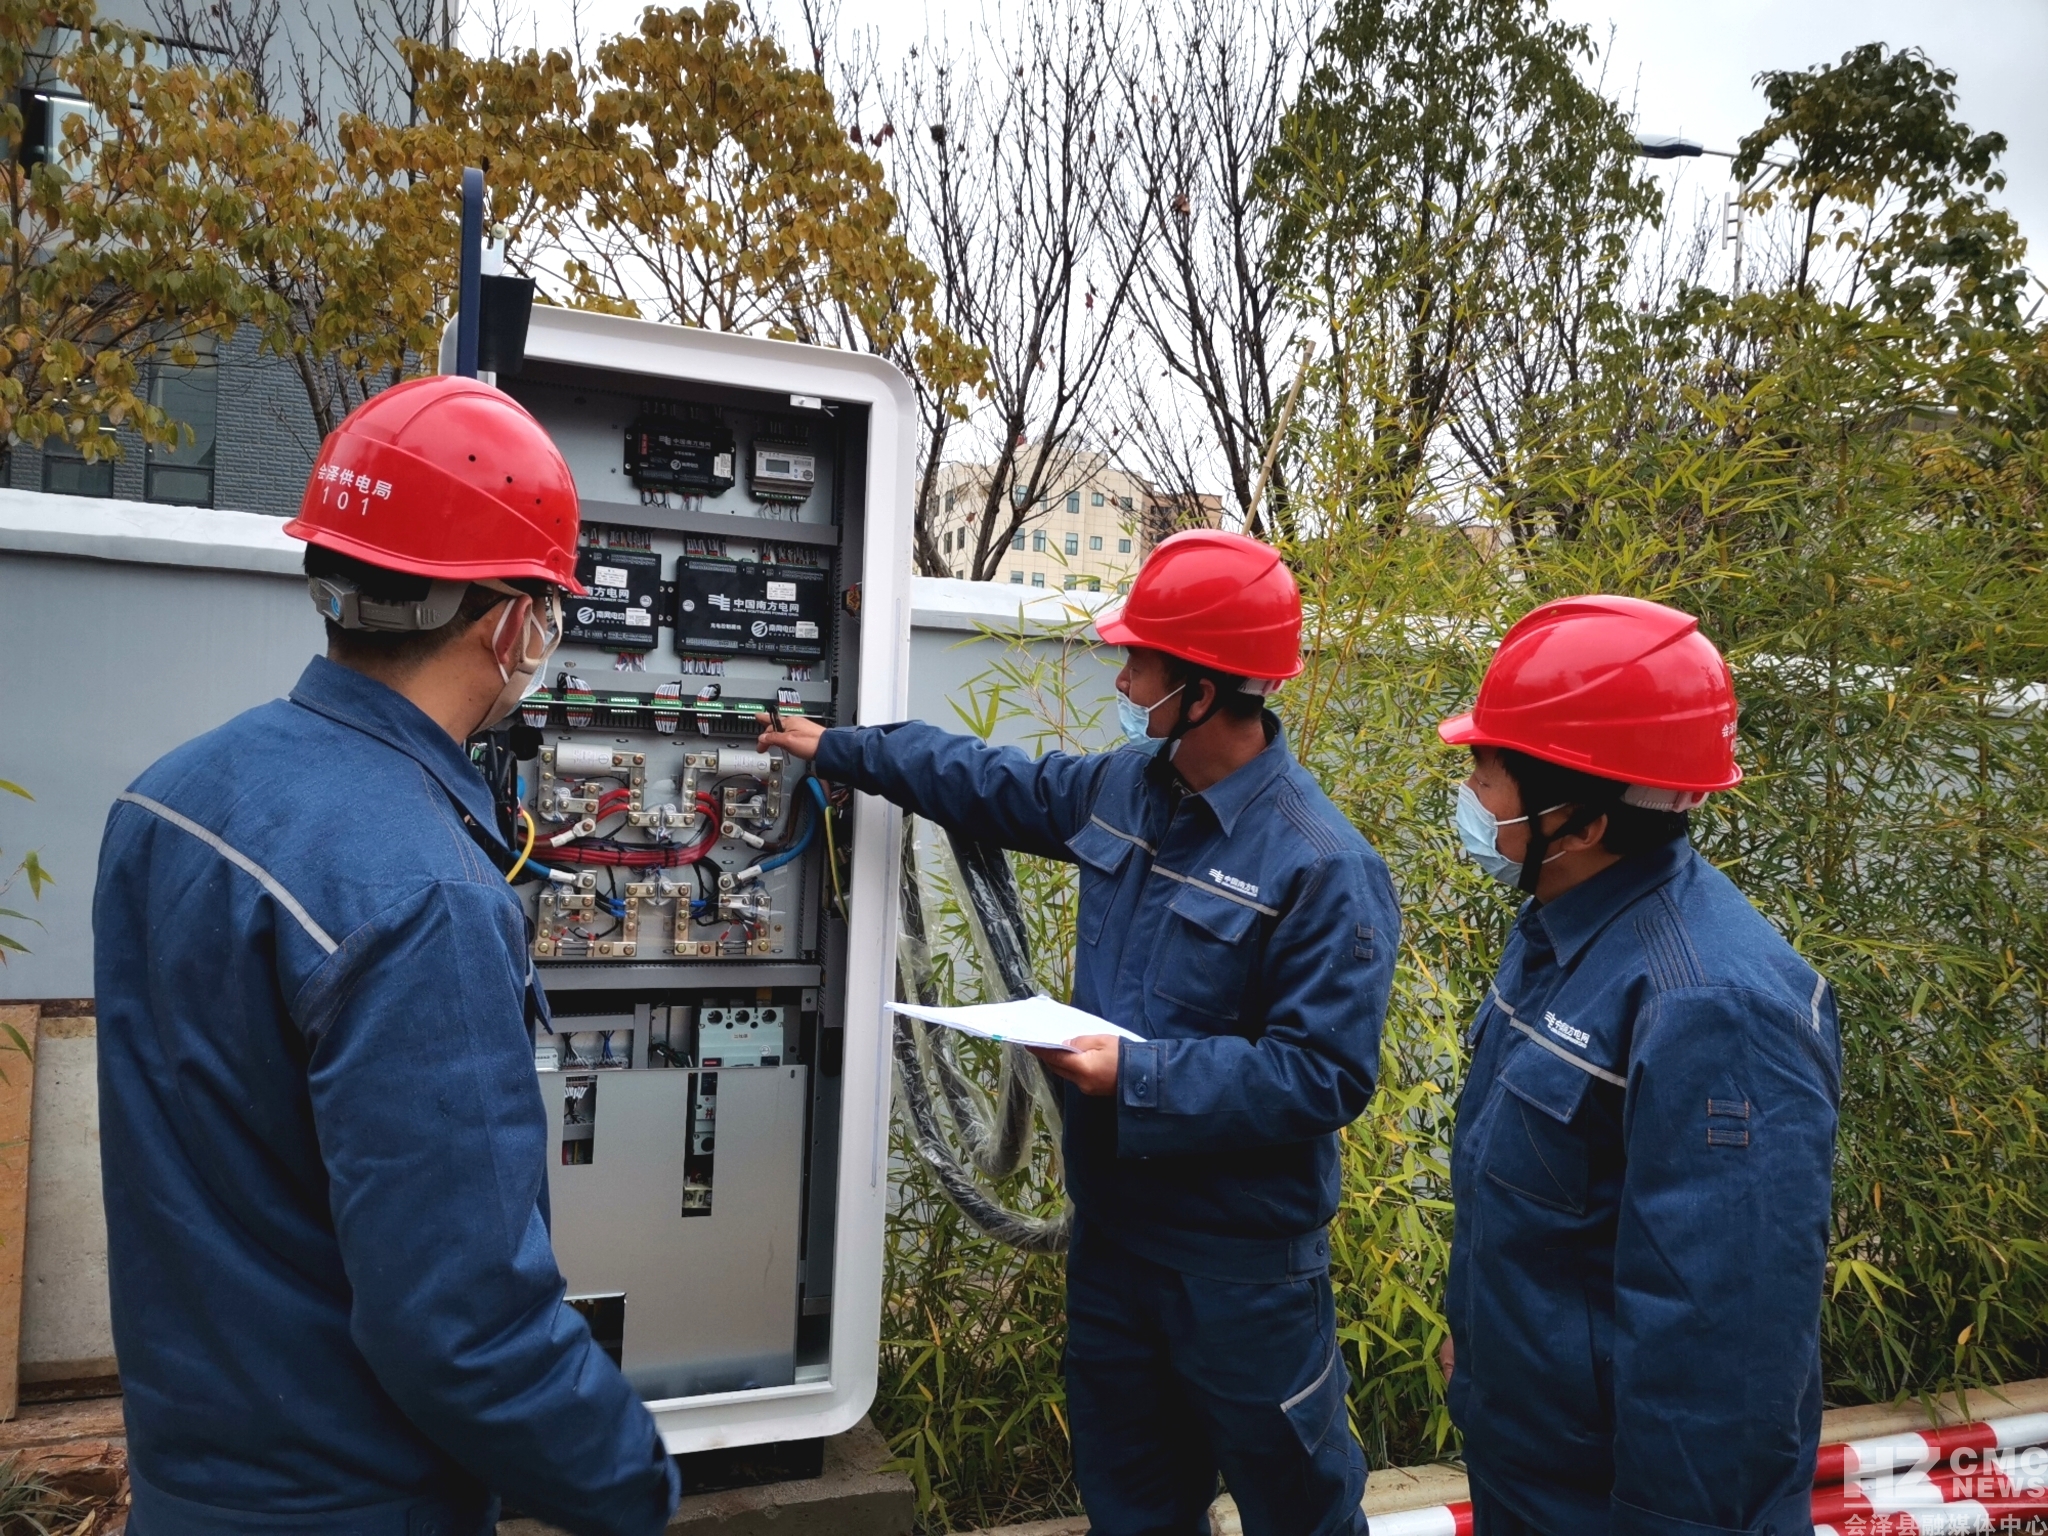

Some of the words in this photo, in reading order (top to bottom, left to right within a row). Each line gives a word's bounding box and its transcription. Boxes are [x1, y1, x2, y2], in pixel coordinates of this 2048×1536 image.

[317, 463, 393, 500] 会泽供电局
[322, 486, 369, 516] 101
[733, 599, 800, 613] 中国南方电网
